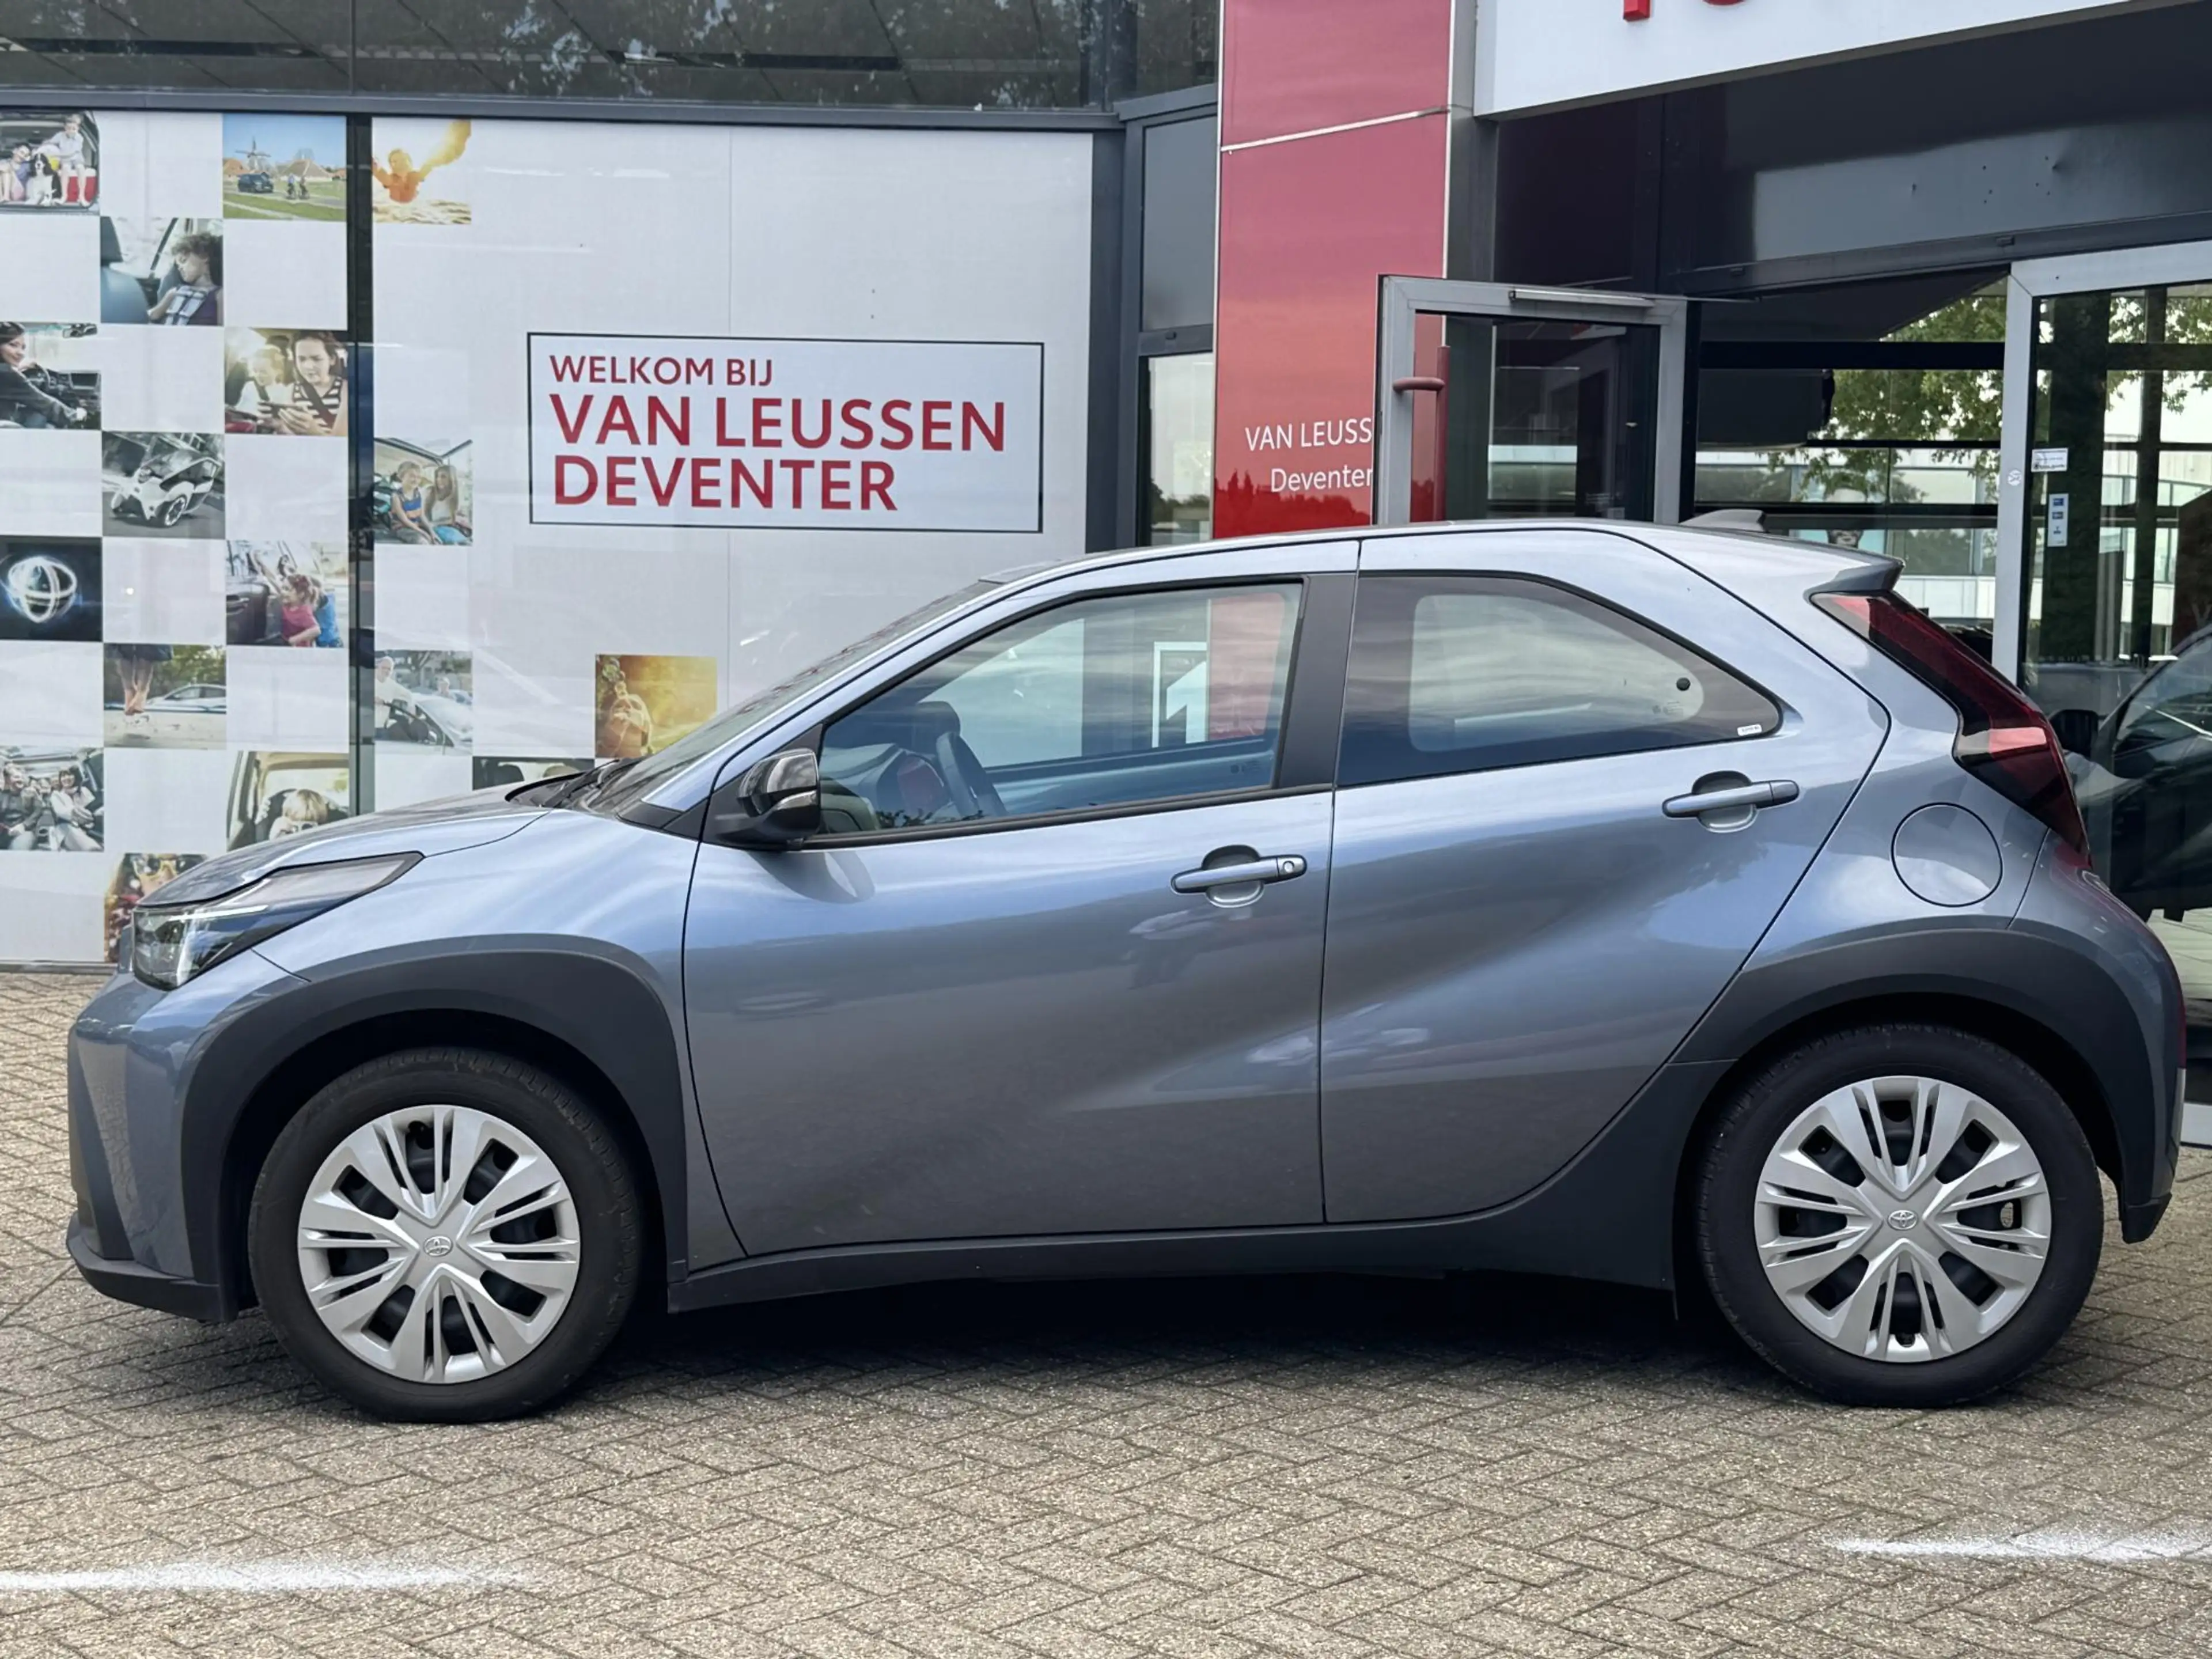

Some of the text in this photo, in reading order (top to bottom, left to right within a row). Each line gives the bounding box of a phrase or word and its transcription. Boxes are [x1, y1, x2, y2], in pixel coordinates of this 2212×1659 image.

[549, 354, 774, 388] WELKOM BIJ
[549, 394, 1005, 452] VAN LEUSSEN
[1244, 423, 1293, 452] VAN
[554, 455, 897, 510] DEVENTER
[1271, 464, 1373, 493] Deventer
